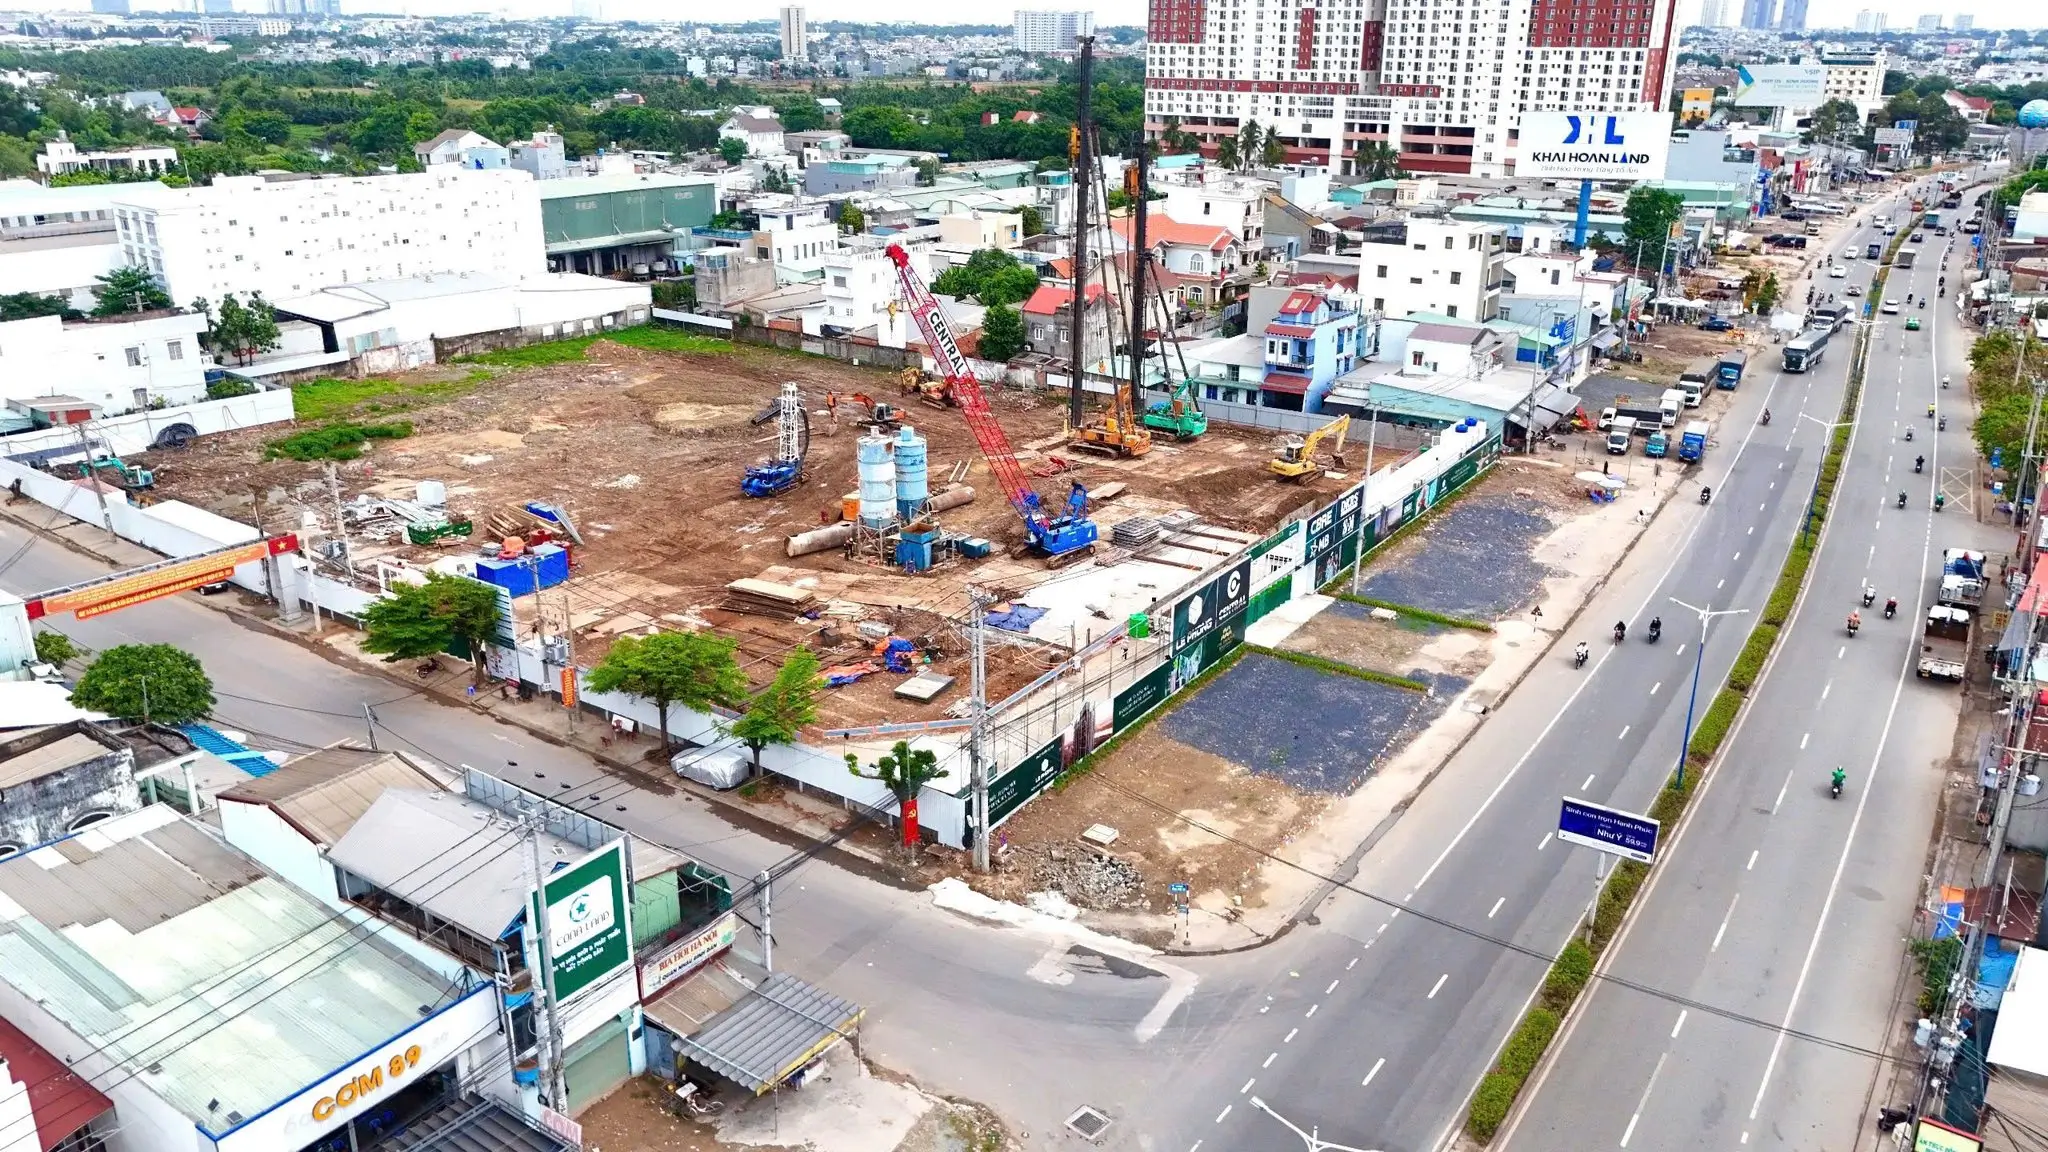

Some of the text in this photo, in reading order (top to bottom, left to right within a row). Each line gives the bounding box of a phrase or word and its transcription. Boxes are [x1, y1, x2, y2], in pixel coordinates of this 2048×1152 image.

[1532, 152, 1650, 164] KHAI HOAN LAND
[930, 312, 964, 376] CENTRAL
[1310, 509, 1333, 535] CBRE
[1318, 534, 1330, 552] MB
[1565, 806, 1582, 816] Sinh
[1582, 811, 1597, 820] con
[1597, 828, 1616, 840] Như
[658, 957, 673, 971] BIA
[311, 1044, 422, 1122] CƠM 89
